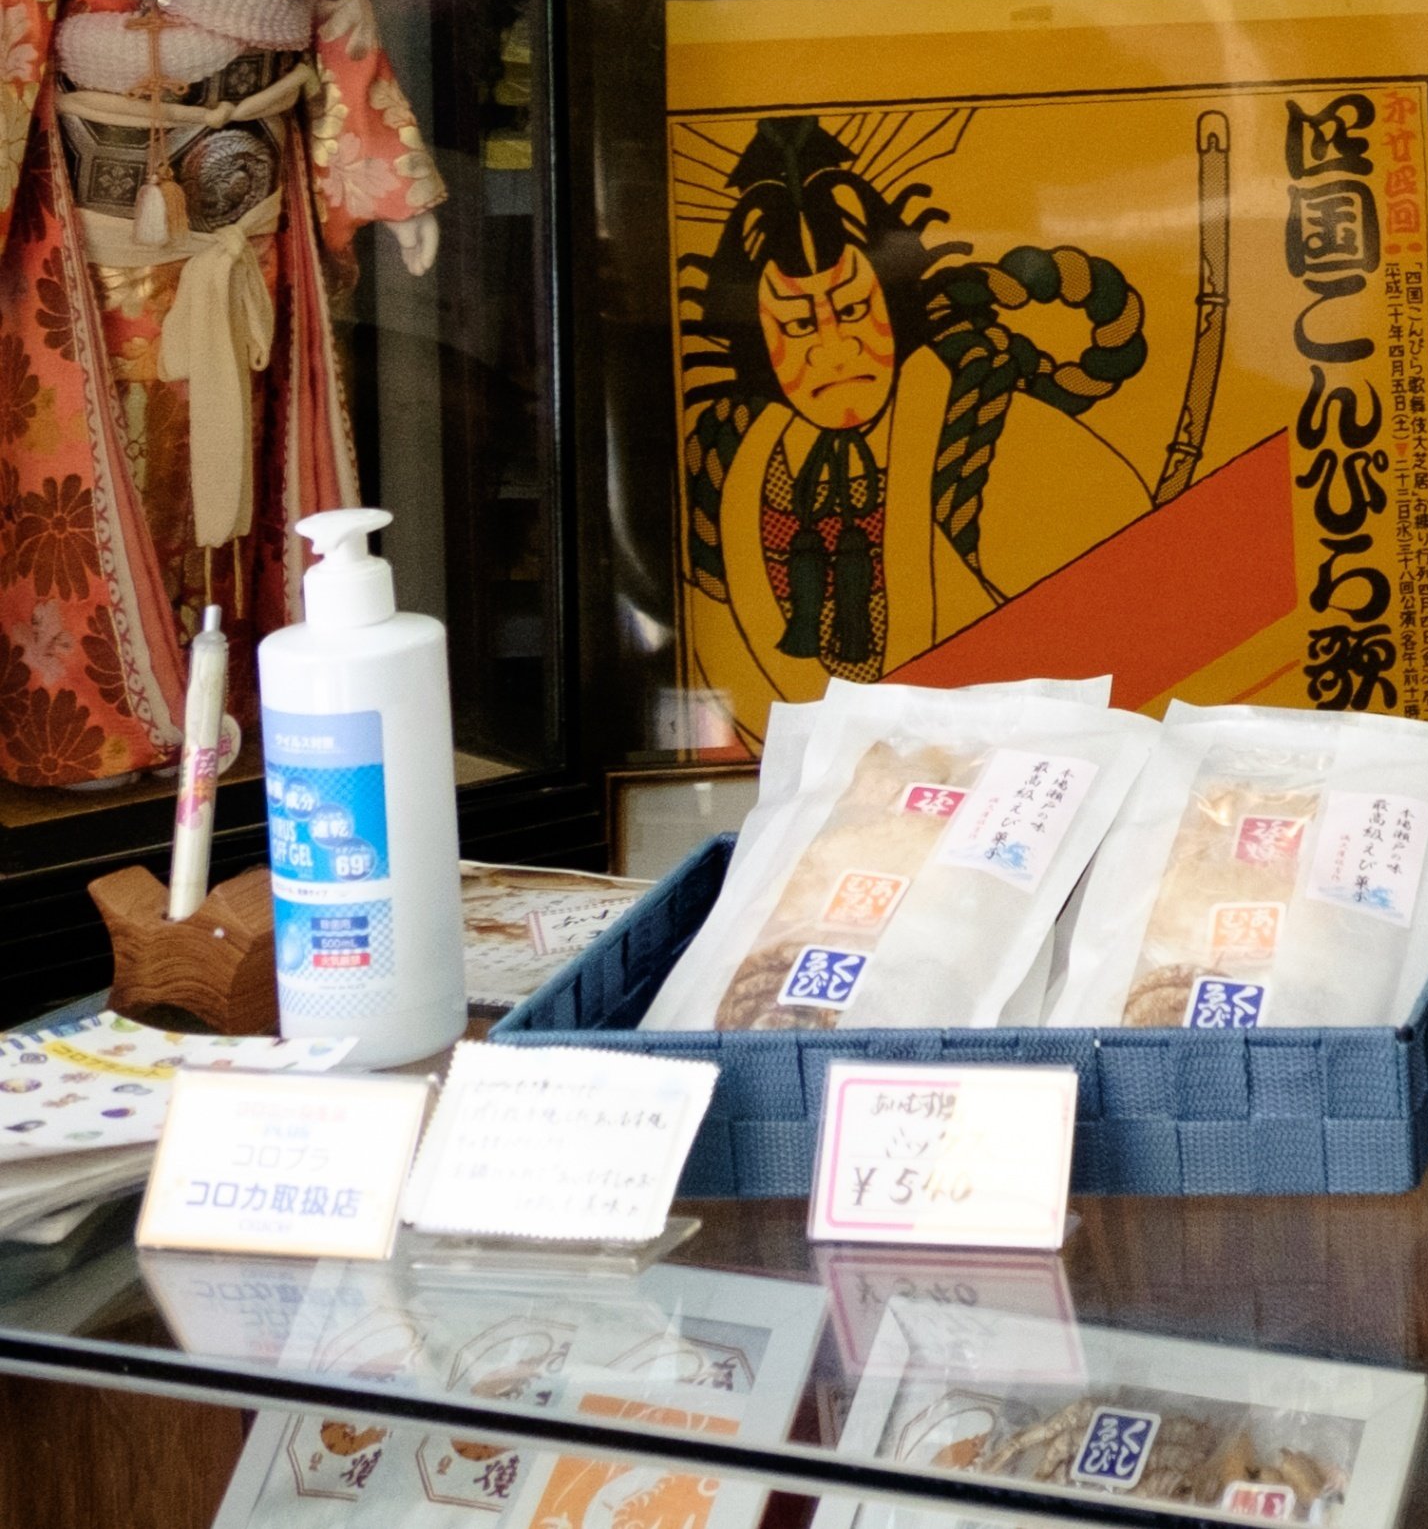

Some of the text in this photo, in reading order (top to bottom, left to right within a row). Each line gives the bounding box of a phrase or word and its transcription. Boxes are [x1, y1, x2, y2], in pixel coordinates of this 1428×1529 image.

[1285, 92, 1396, 710] 四国こんぴら歌
[185, 1180, 363, 1218] コロカ取扱店
